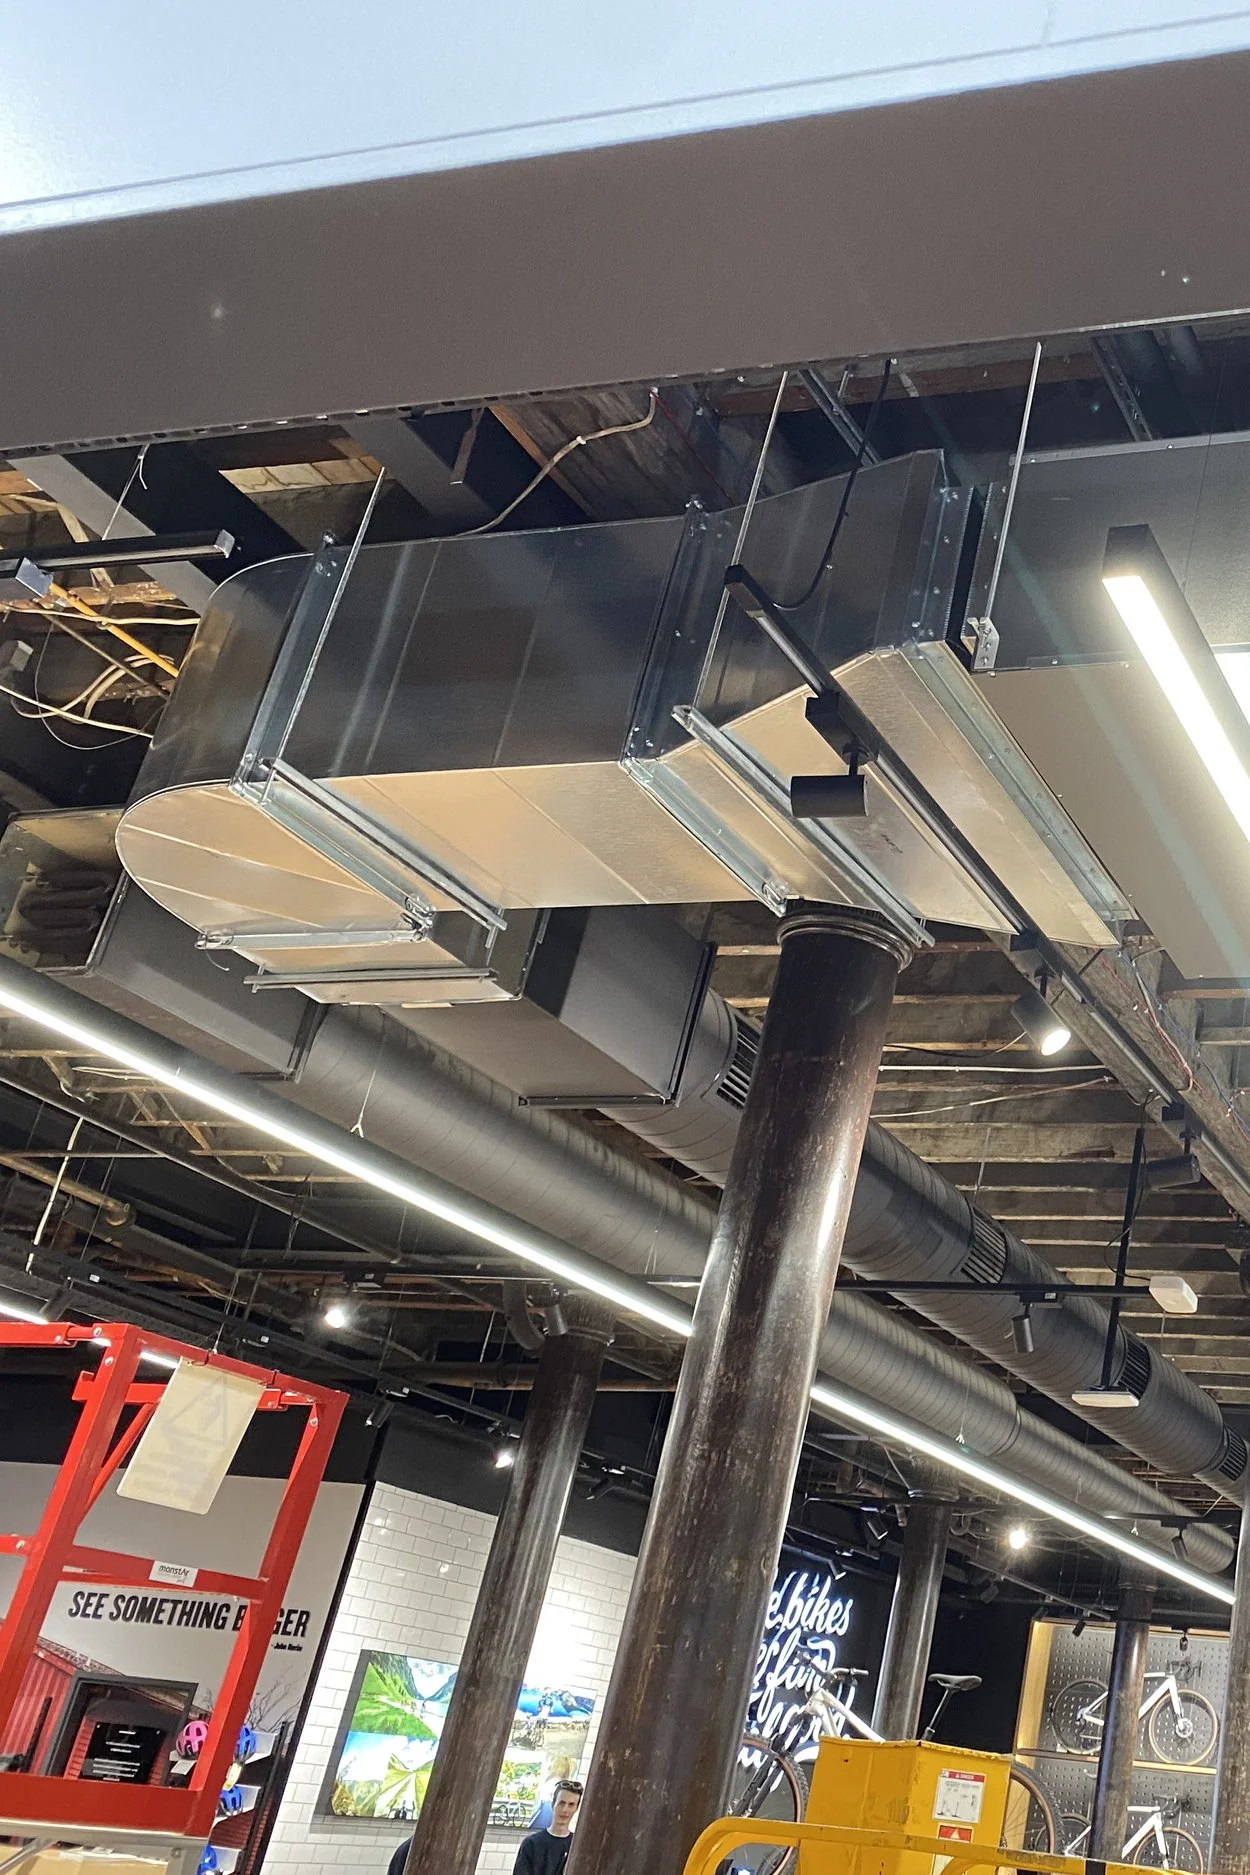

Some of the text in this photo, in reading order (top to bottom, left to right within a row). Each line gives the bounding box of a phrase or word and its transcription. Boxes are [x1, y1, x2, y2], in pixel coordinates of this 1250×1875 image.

[68, 1590, 311, 1638] SEE SOMETHING BGER
[782, 1573, 854, 1635] bikes
